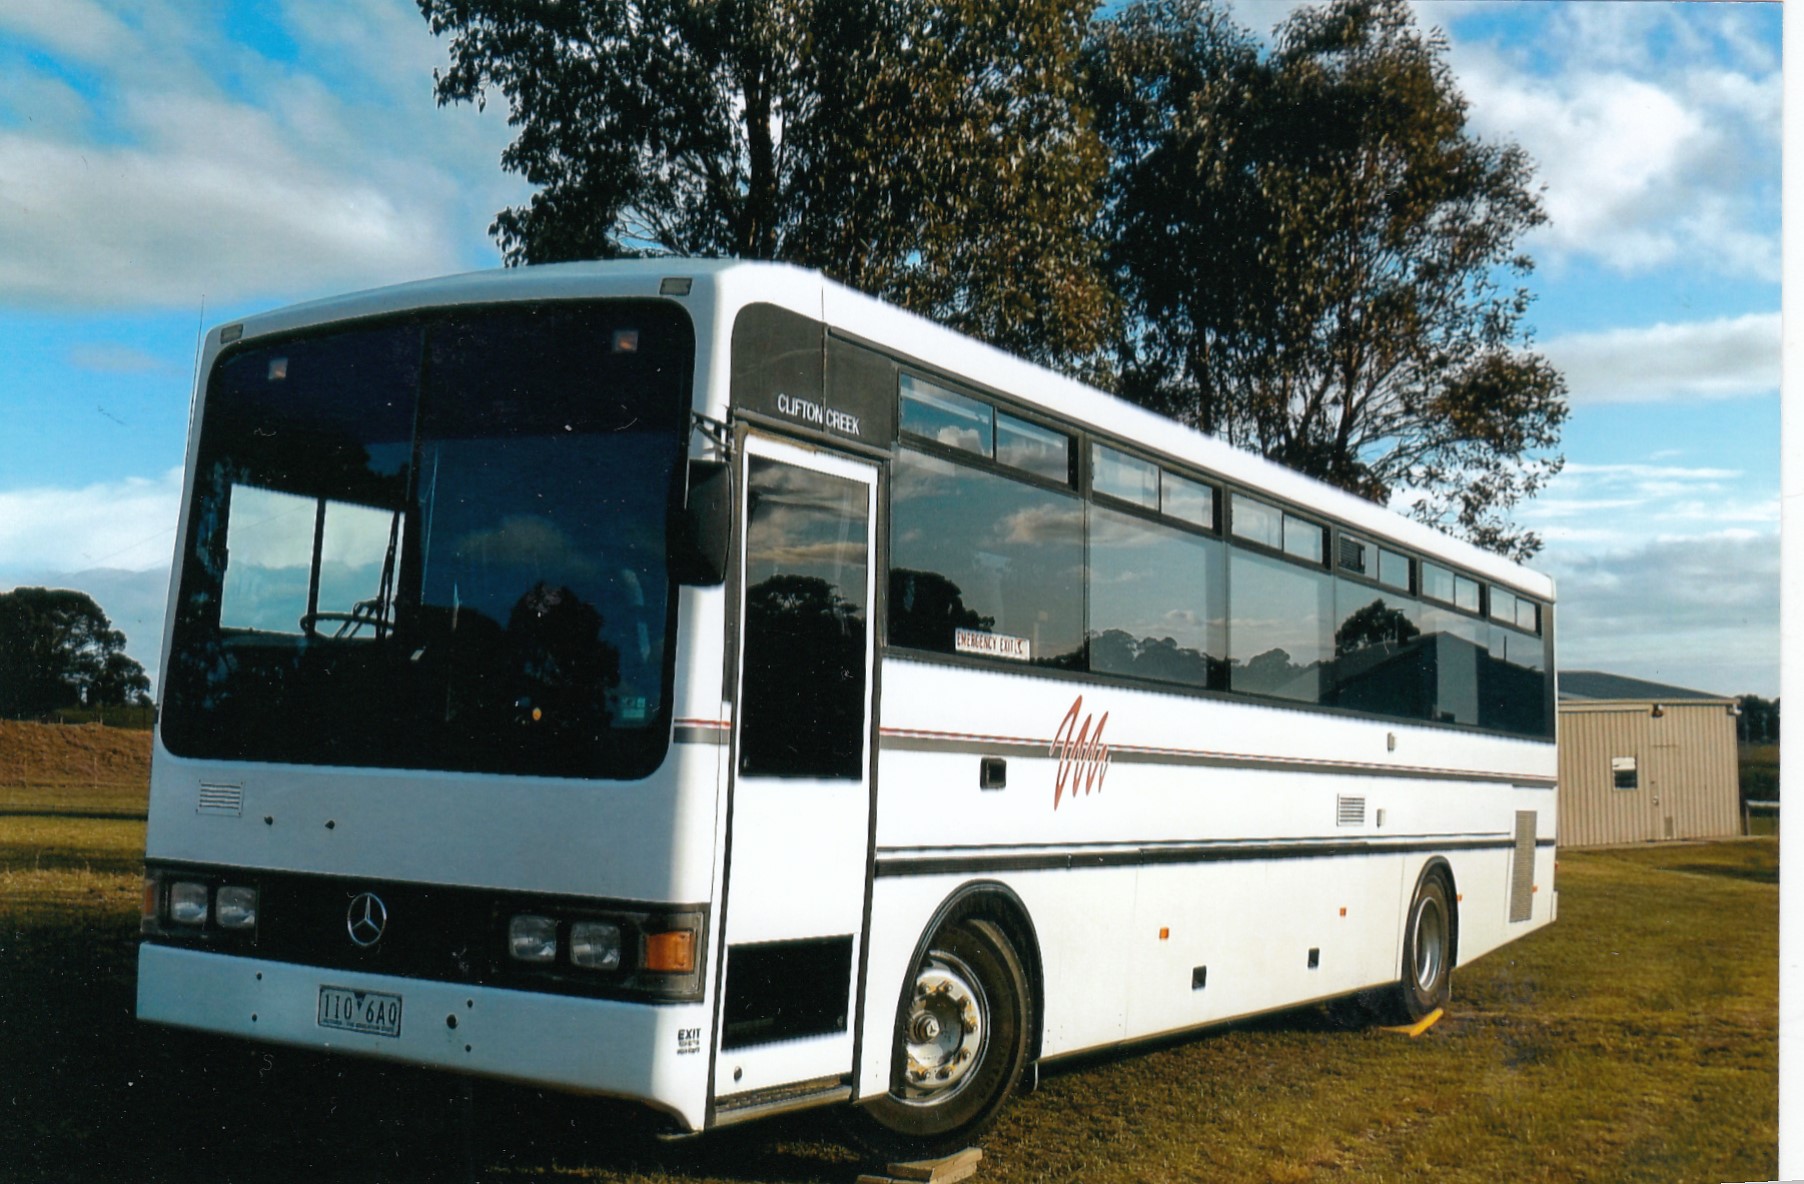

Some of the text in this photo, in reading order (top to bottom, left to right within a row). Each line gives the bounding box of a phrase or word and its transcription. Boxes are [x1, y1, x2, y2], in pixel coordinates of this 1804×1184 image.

[777, 393, 860, 435] CLIFTON CREEK
[957, 631, 997, 650] EMERGENCY
[677, 1027, 701, 1040] EXIT
